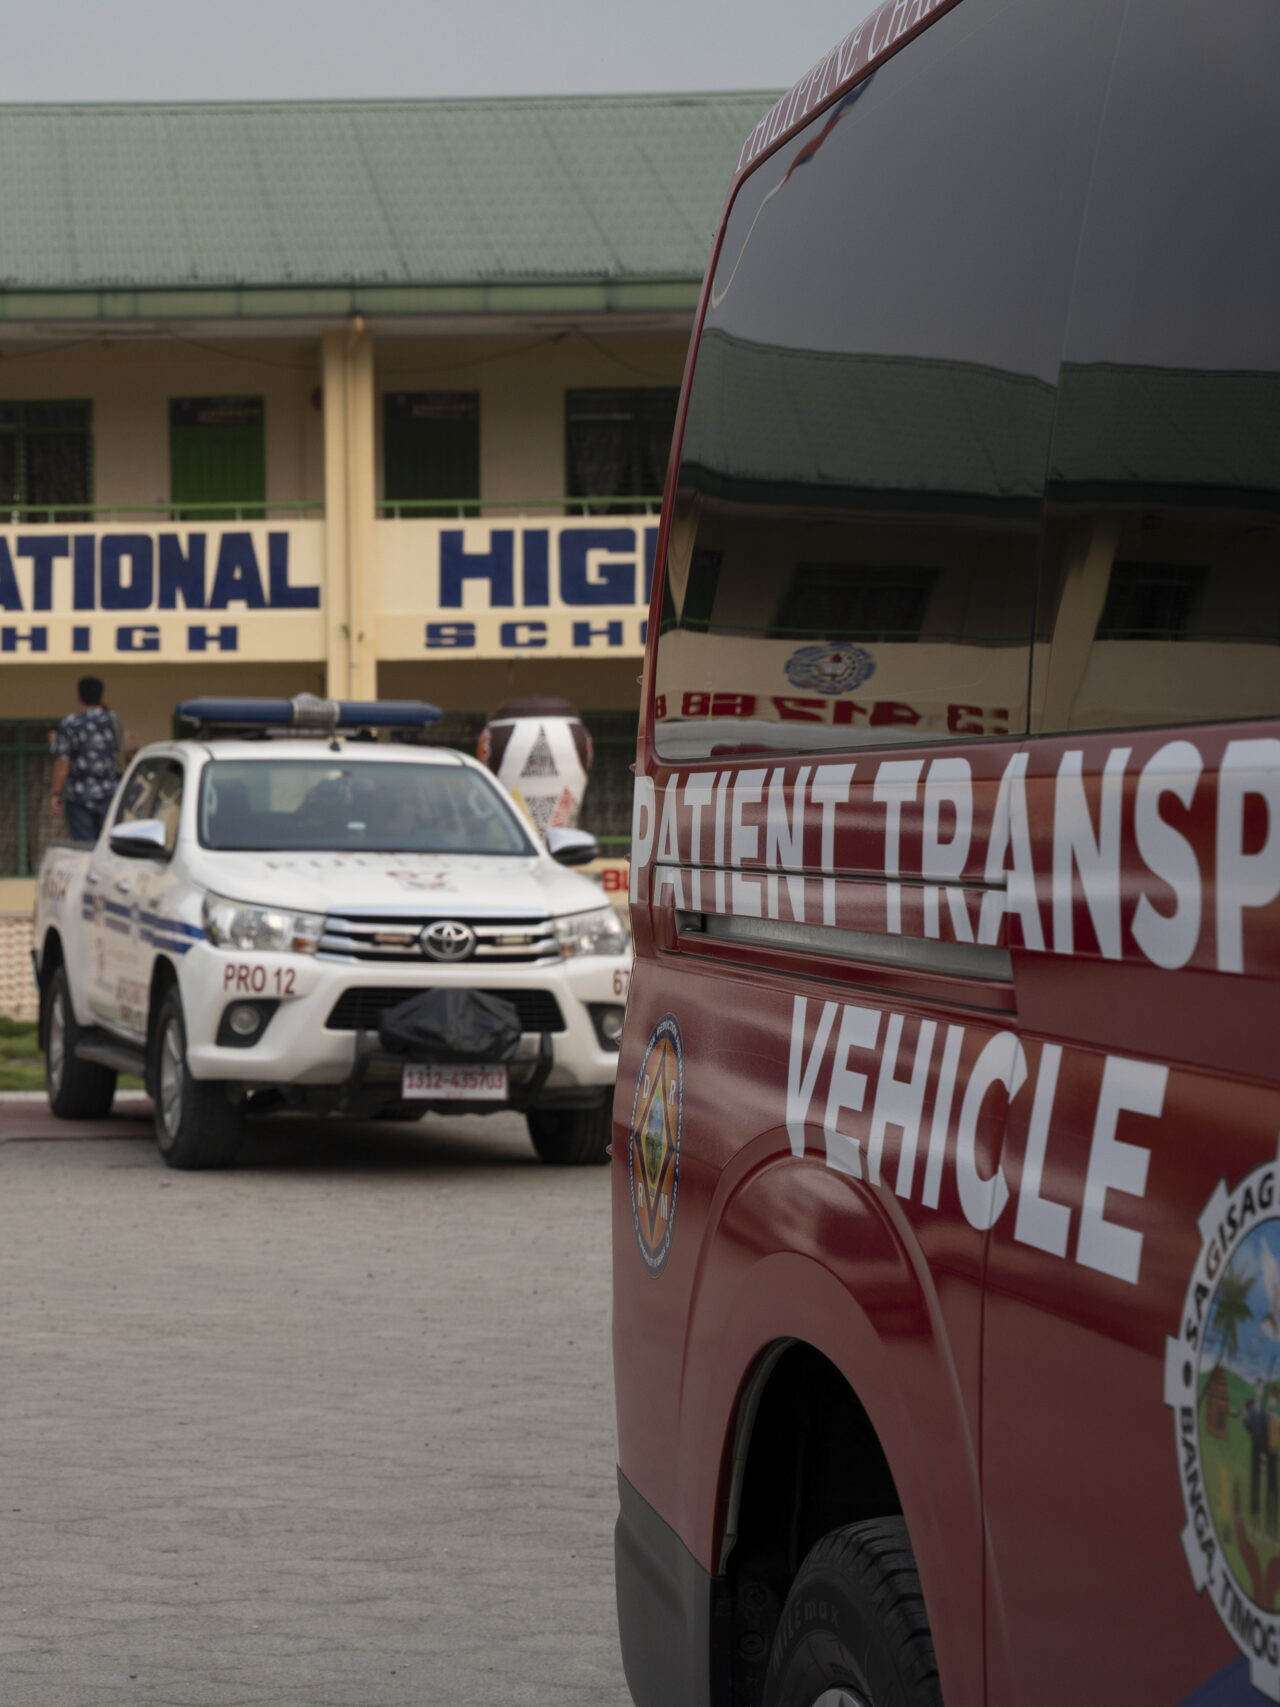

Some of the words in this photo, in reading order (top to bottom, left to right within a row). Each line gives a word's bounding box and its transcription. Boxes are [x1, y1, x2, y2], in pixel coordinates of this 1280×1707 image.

[439, 527, 659, 609] HIG
[0, 625, 238, 652] HIGH
[425, 620, 648, 649] SCH
[629, 763, 857, 927] PATIENT
[873, 738, 1280, 975] TRANSP
[224, 963, 266, 993] PRO
[274, 967, 296, 995] 12
[786, 995, 1169, 1284] VEHICLE
